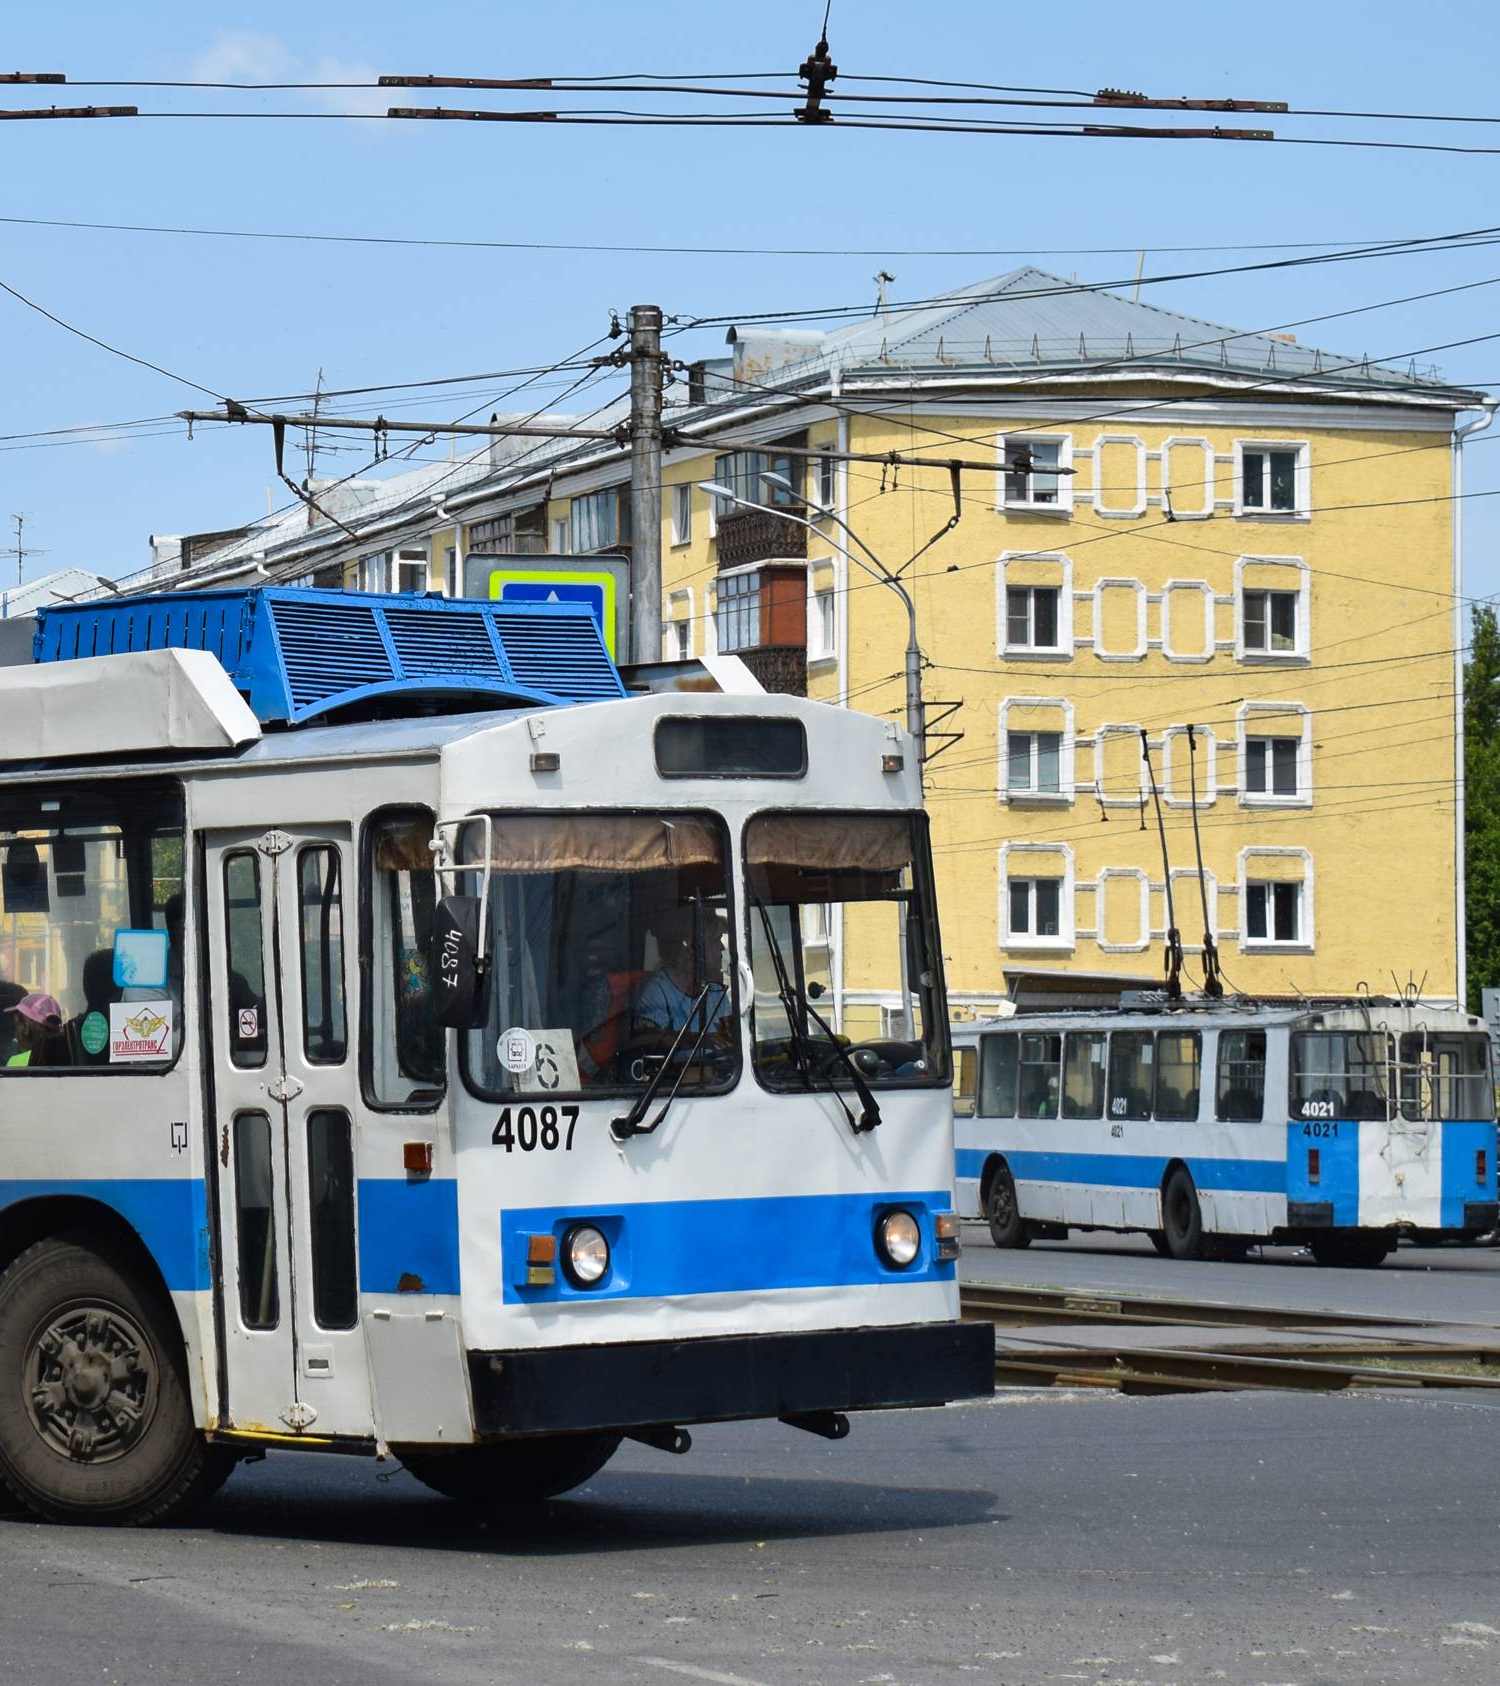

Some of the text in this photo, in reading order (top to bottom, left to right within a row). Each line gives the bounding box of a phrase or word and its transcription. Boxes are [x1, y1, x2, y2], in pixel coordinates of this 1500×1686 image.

[442, 930, 463, 988] 4087
[535, 1043, 560, 1089] 6
[1111, 1097, 1127, 1114] 4021
[1301, 1101, 1335, 1117] 4021
[492, 1105, 579, 1152] 4087
[1302, 1122, 1339, 1138] 4021
